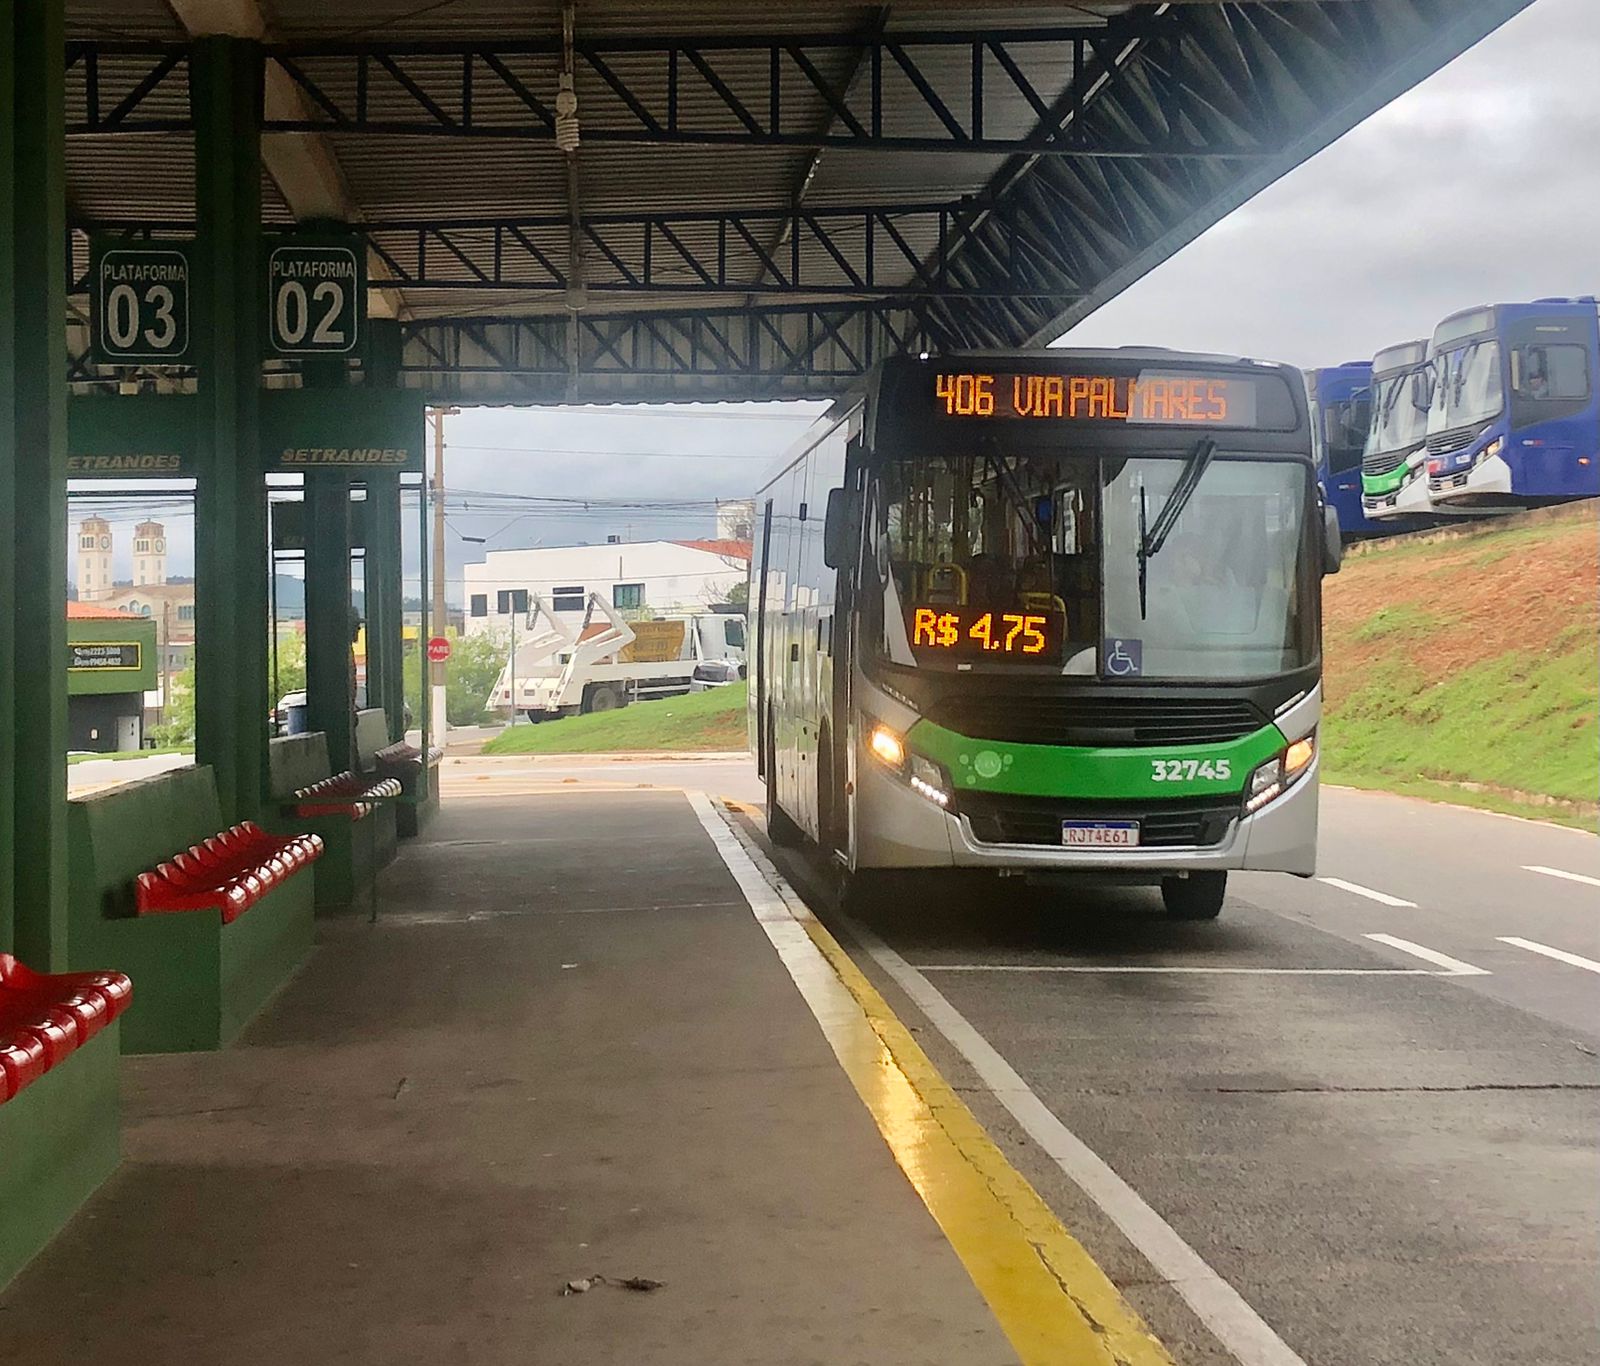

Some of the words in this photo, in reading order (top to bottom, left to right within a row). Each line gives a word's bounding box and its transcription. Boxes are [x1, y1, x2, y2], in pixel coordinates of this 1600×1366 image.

[103, 264, 186, 281] PLATAFORMA
[272, 261, 354, 278] PLATAFORMA
[107, 284, 176, 348] 03
[276, 281, 345, 343] 02
[936, 375, 993, 415] 406
[1014, 376, 1064, 417] VIA
[67, 454, 181, 469] ETRANDES
[281, 448, 408, 462] SETRANDES
[913, 608, 960, 647] R$
[1151, 759, 1231, 781] 32745
[1069, 829, 1129, 843] RJT4E61
